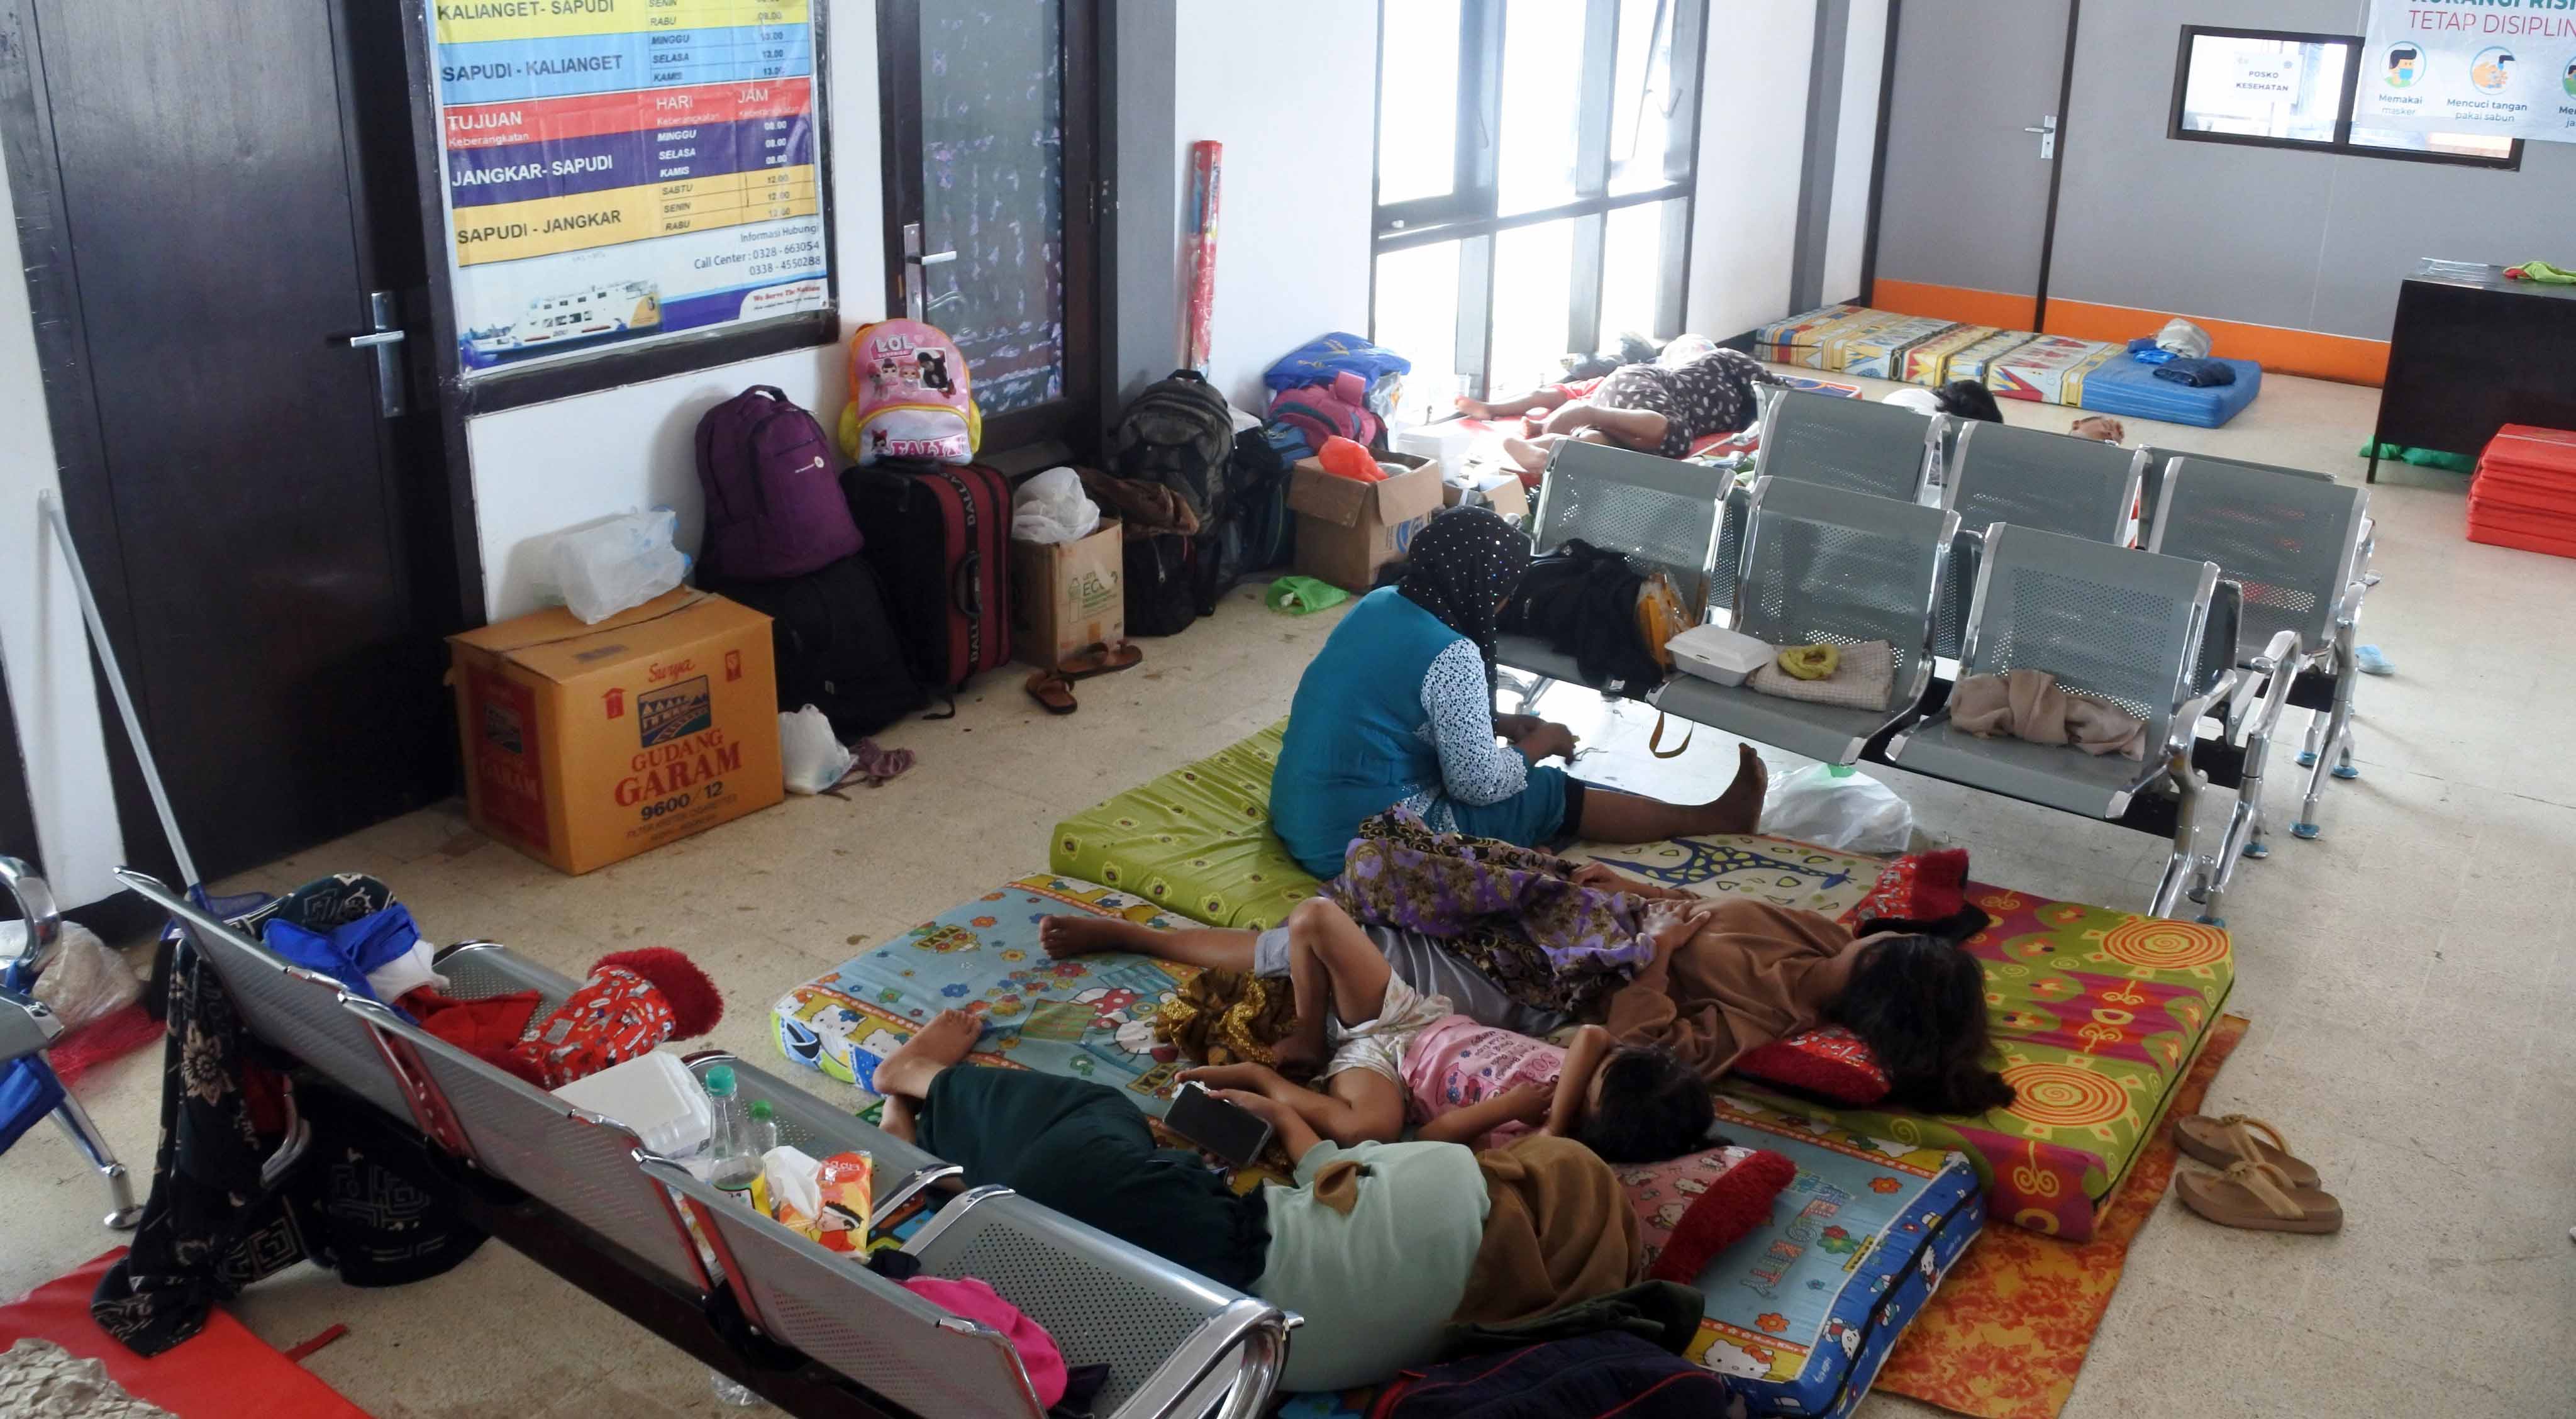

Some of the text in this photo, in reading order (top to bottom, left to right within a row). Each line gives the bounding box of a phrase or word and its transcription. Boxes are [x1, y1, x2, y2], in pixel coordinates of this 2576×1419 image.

[552, 0, 614, 14] SAPUDI
[650, 17, 677, 26] RABU
[2409, 10, 2476, 31] TETAP
[652, 35, 690, 45] MINGGU
[653, 53, 689, 64] SELASA
[442, 64, 512, 82] SAPUDI
[526, 55, 623, 75] KALIANGET
[2248, 70, 2279, 79] POSKO
[653, 72, 682, 82] KAMIS
[2236, 82, 2289, 91] KESEHATAN
[656, 95, 692, 111] HARI
[738, 89, 769, 104] JAM
[2379, 94, 2423, 104] Memakai
[2446, 98, 2528, 113] Mencuci tangan
[447, 111, 522, 131] TUJUAN
[2455, 111, 2515, 123] pakai sabun
[449, 132, 530, 147] Keberangkatan
[657, 130, 697, 142] MINGGU
[659, 148, 696, 160] SELASA
[552, 155, 613, 176] SAPUDI
[660, 167, 690, 178] KAMIS
[662, 183, 693, 196] SABTU
[664, 203, 691, 214] SENIN
[458, 223, 527, 244] SAPUDI
[543, 210, 621, 233] JANGKAR
[665, 221, 690, 231] RABU
[740, 224, 819, 243] Informasi Hubungi
[694, 257, 712, 270] Call
[714, 253, 747, 266] Center
[753, 247, 777, 260] 0328
[784, 241, 819, 255] 663054
[749, 263, 774, 275] 0338
[780, 256, 821, 270] 4550288
[875, 333, 916, 353] LOL
[648, 657, 696, 683] Surya
[631, 728, 724, 772] GUDANG
[614, 740, 742, 807] GARAM
[641, 793, 690, 821] 9600
[704, 781, 723, 799] 12
